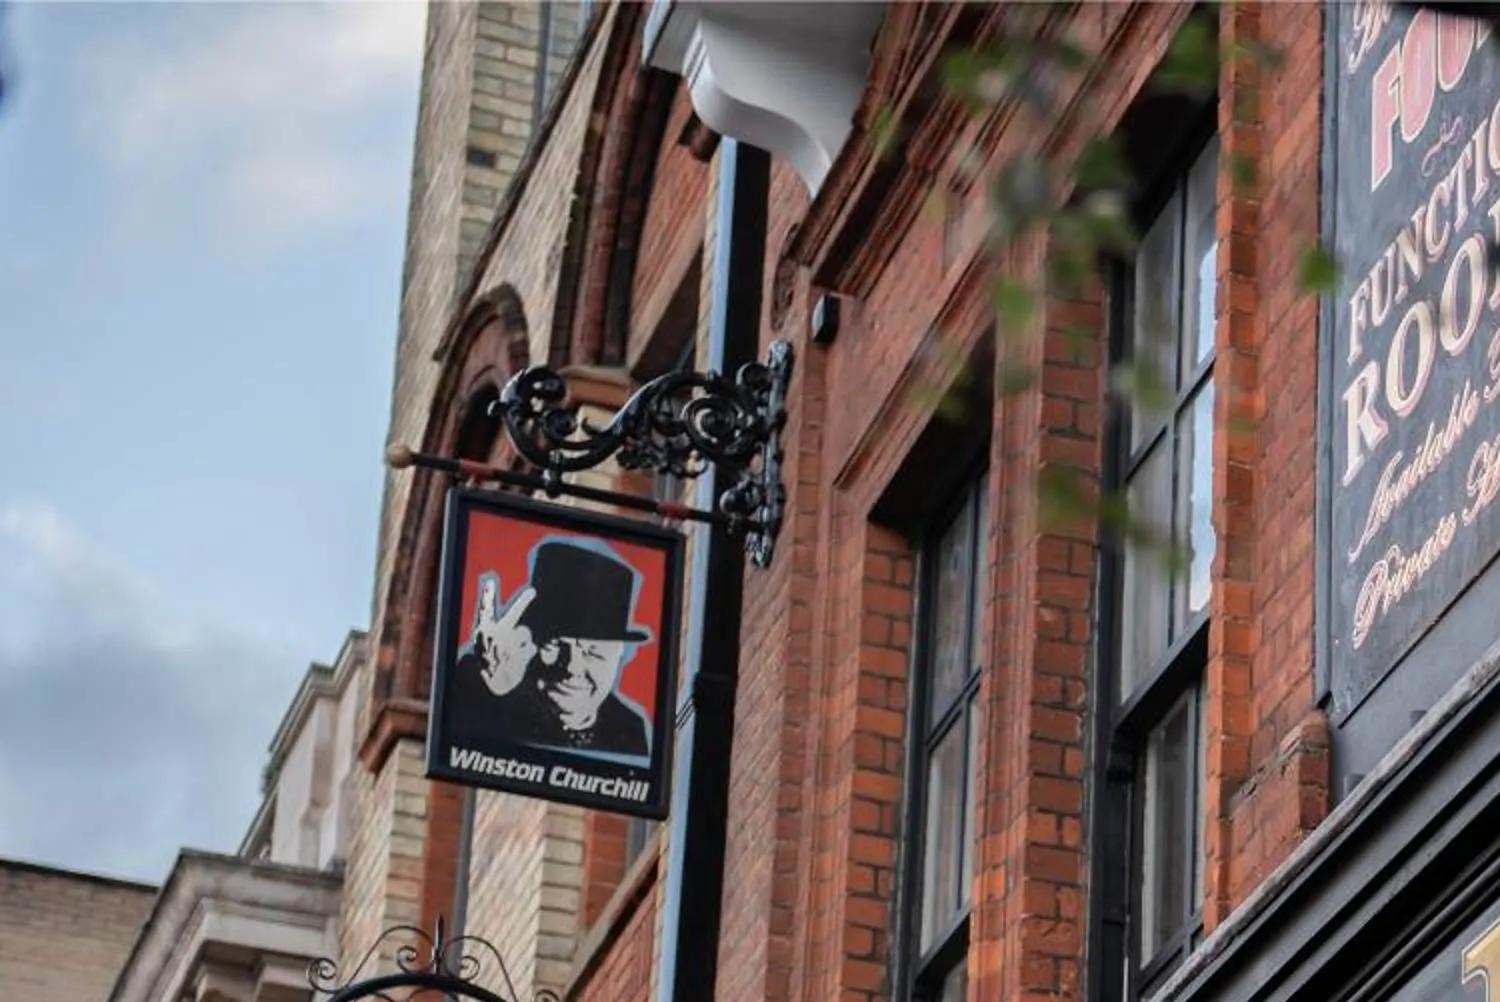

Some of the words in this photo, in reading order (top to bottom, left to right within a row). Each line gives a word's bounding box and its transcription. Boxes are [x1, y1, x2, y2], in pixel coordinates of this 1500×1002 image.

[1371, 7, 1496, 193] FOO
[1347, 376, 1479, 564] Available
[1352, 544, 1457, 650] Private
[450, 746, 545, 784] Winston
[549, 765, 649, 802] Churchill
